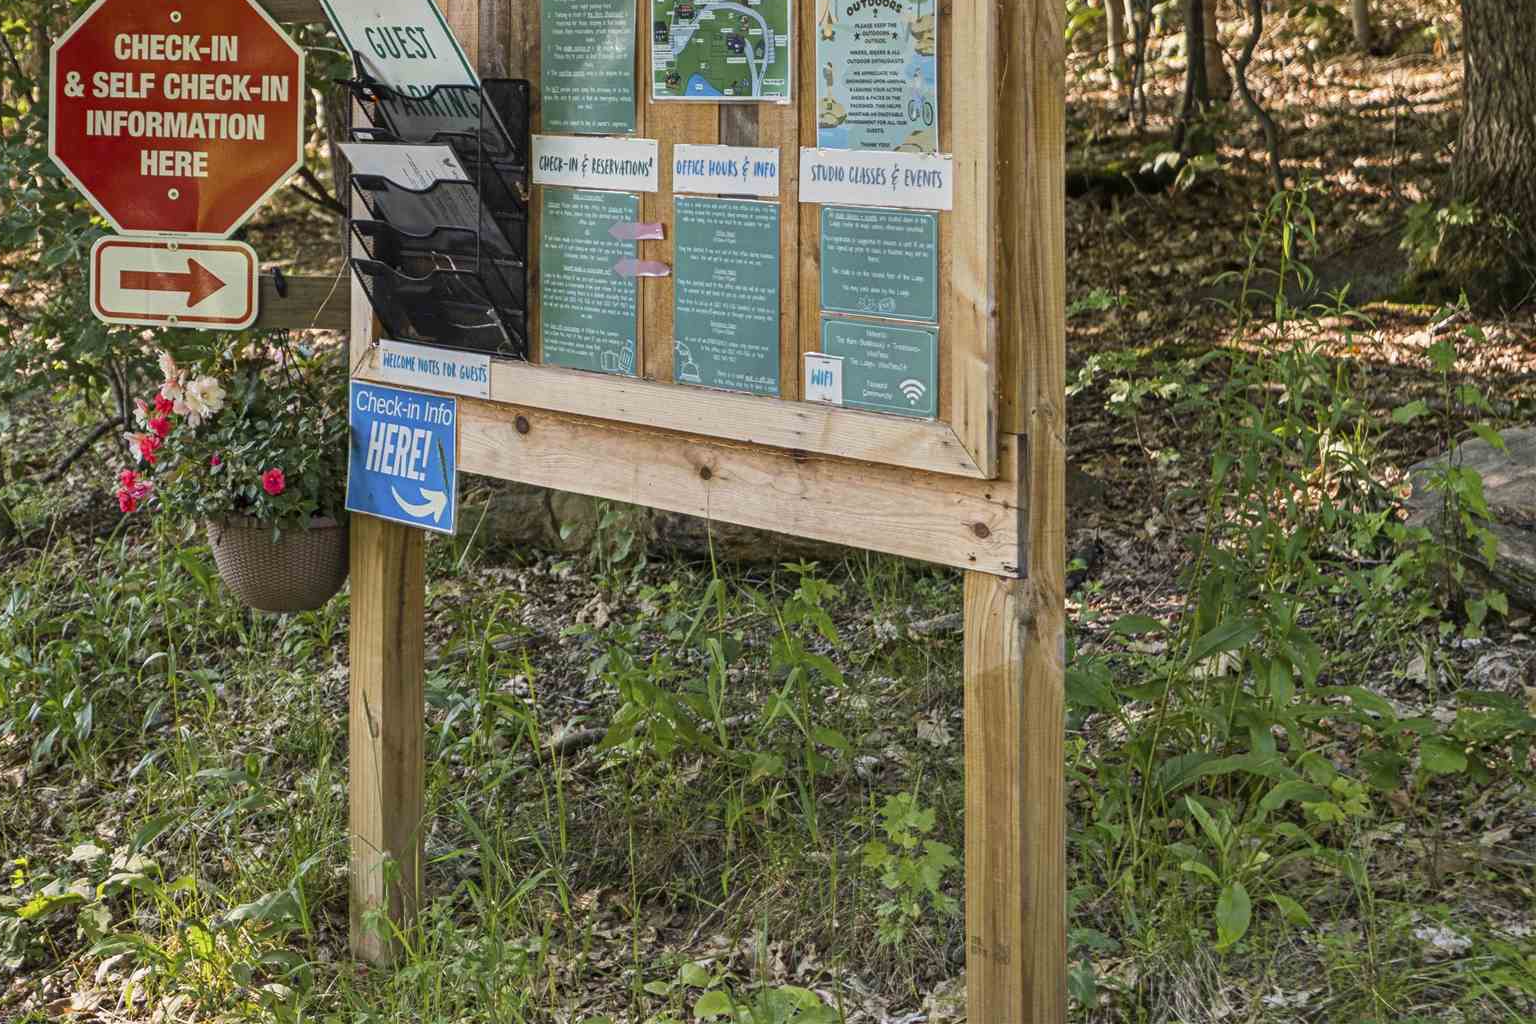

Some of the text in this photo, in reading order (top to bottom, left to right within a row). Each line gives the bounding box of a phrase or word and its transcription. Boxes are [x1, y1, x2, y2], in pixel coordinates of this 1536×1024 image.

[114, 33, 239, 63] CHECK-IN
[364, 26, 437, 60] GUEST
[63, 71, 289, 102] & SELF CHECK-IN
[85, 109, 265, 141] INFORMATION
[140, 149, 209, 178] HERE
[539, 154, 578, 173] CHECK-IN
[676, 159, 705, 176] OFFICE
[708, 159, 738, 177] HOURS
[754, 160, 776, 178] INFO
[811, 164, 845, 182] STUDIO
[848, 165, 887, 185] CLASSES
[904, 169, 943, 189] EVENTS
[383, 351, 488, 384] WELCOME NOTES FOR GUESTS
[810, 368, 833, 387] WIFI
[356, 390, 453, 426] Check-in Info
[366, 421, 433, 481] HERE!
